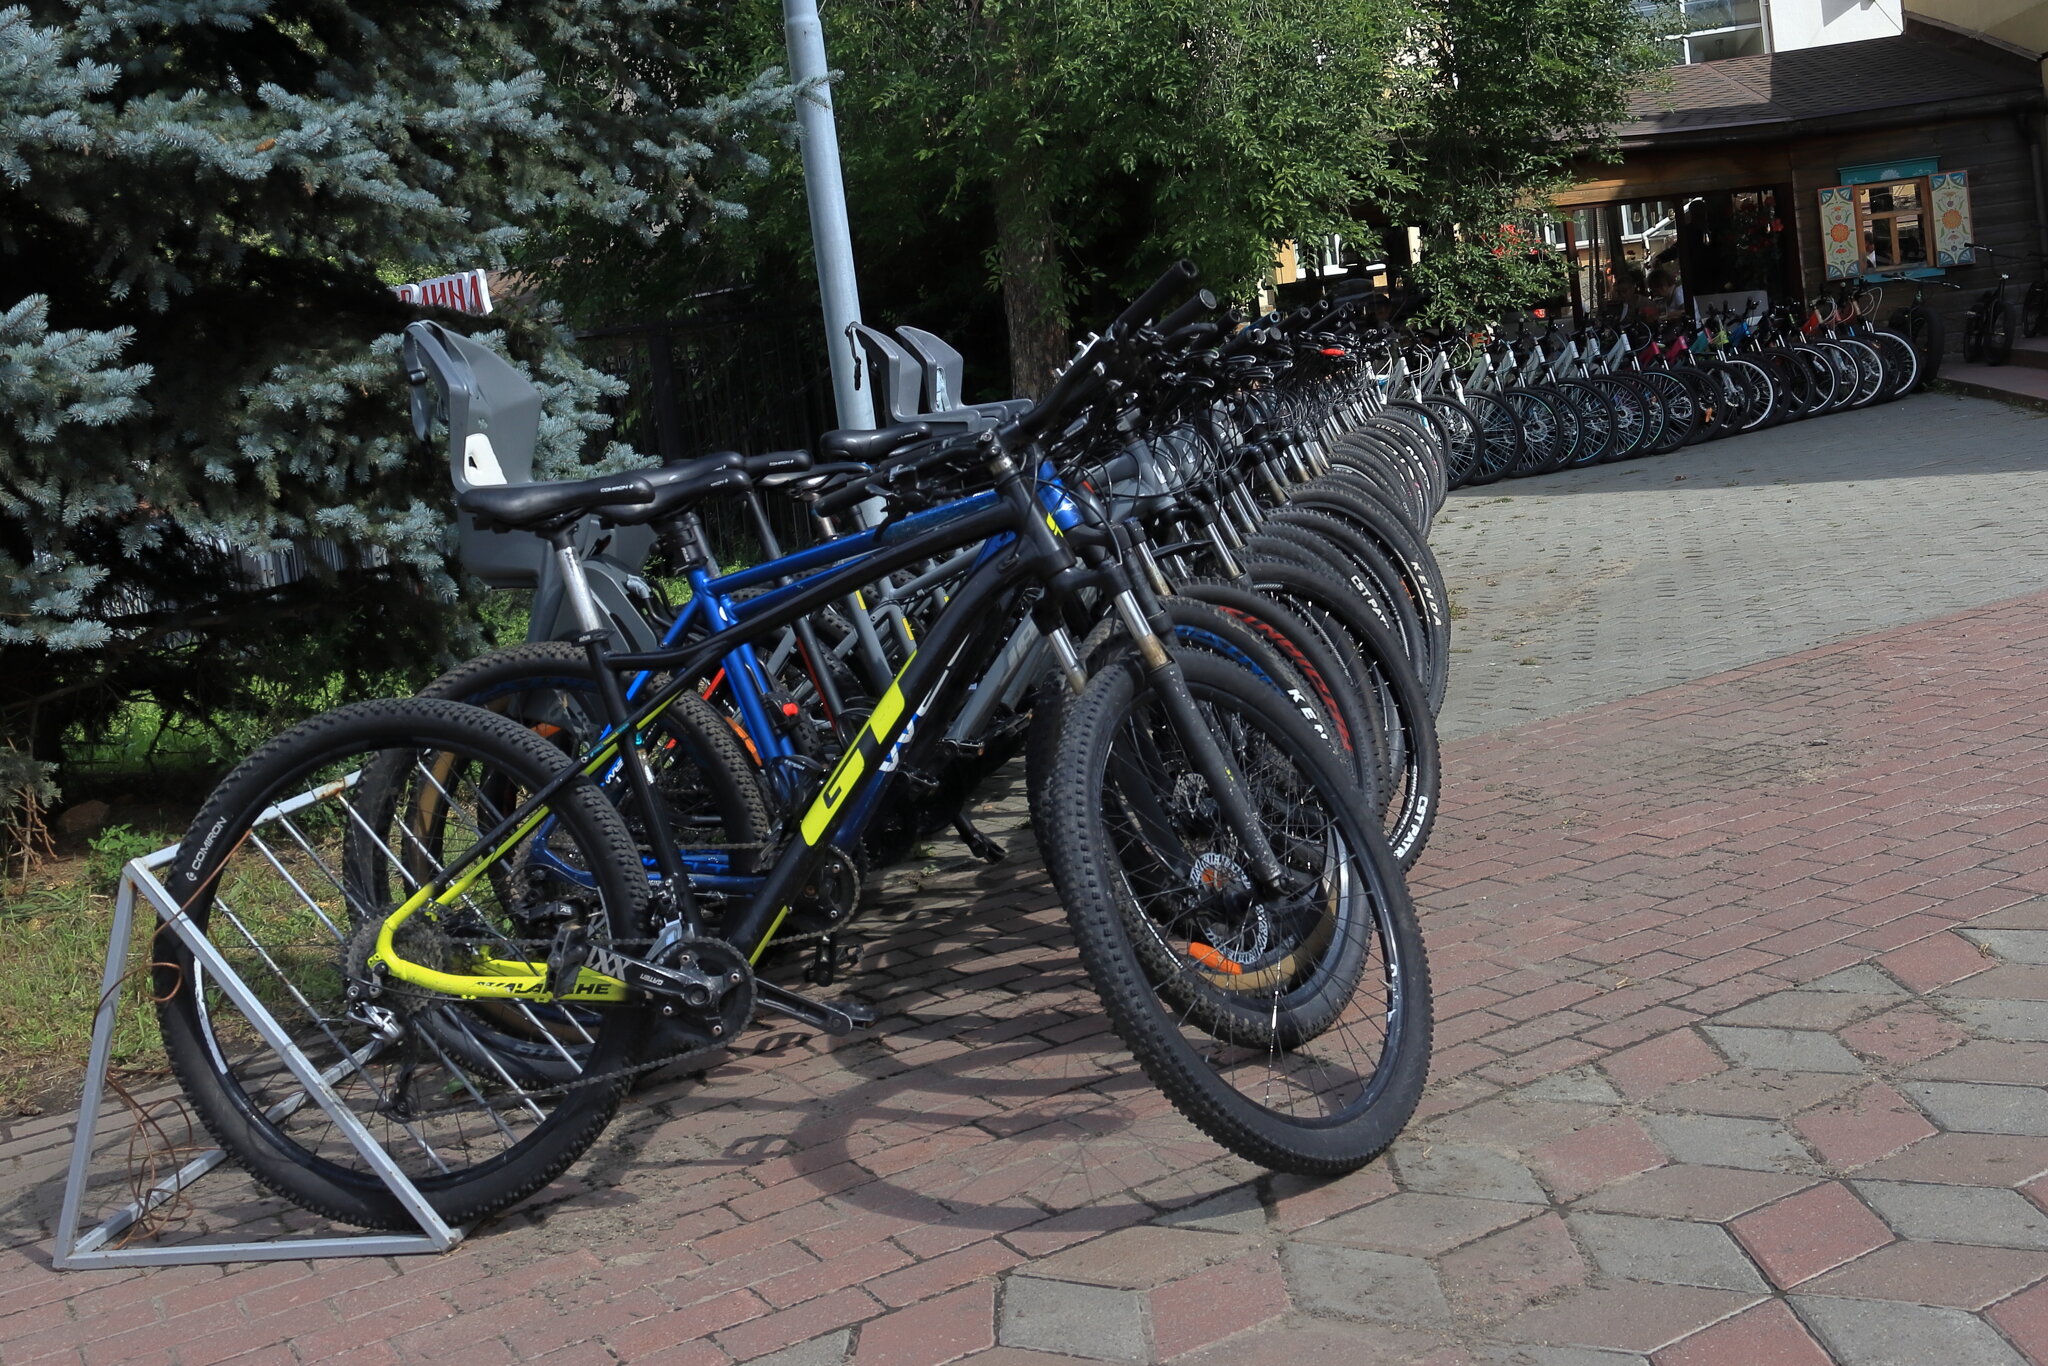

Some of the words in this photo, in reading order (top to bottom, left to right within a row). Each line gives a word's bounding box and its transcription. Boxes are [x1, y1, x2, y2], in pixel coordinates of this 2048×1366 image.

[1376, 423, 1401, 437] KENDA
[1350, 575, 1372, 597] CST
[1411, 561, 1442, 626] KENDA
[1414, 795, 1429, 825] CST
[191, 816, 227, 871] COMIRON
